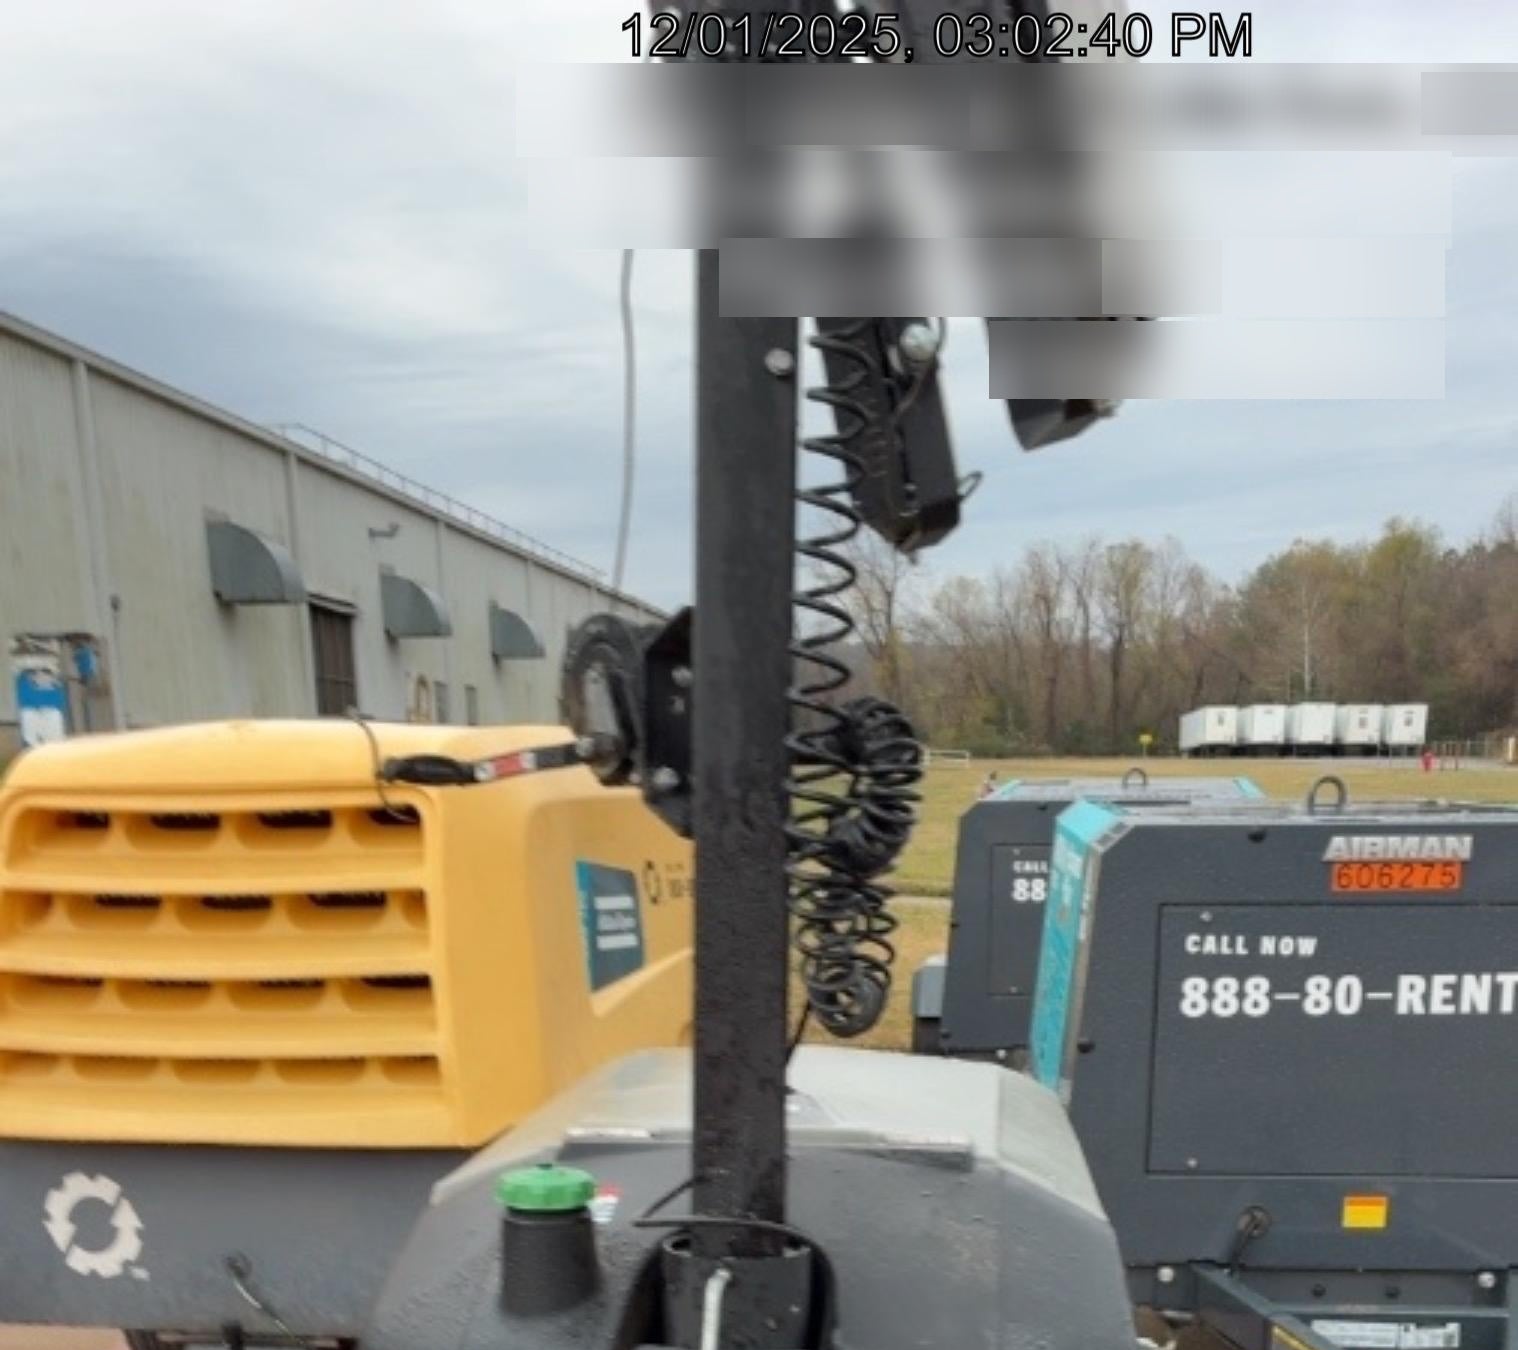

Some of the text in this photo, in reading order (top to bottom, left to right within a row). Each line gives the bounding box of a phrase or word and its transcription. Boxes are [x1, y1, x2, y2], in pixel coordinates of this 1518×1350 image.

[1322, 834, 1474, 861] AIRMAN
[1013, 860, 1048, 874] CALL
[1336, 861, 1457, 889] 606275
[1184, 934, 1318, 957] CALL NOW
